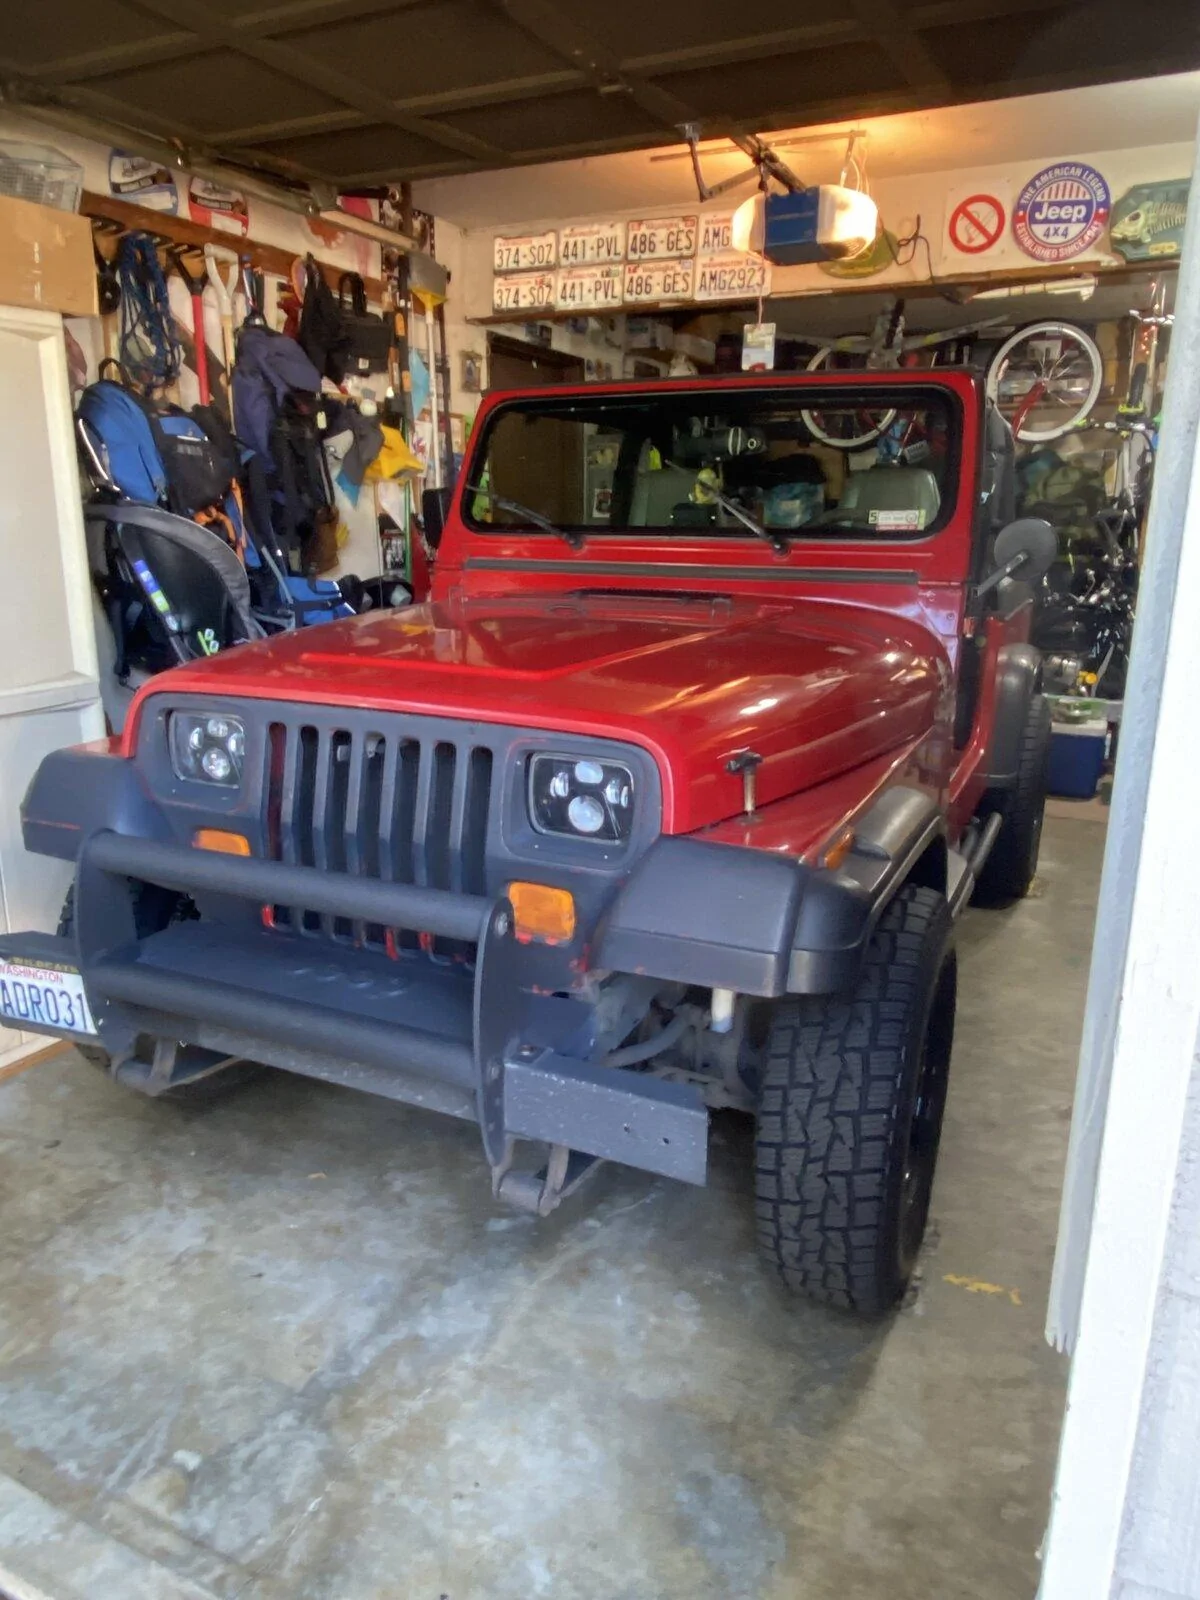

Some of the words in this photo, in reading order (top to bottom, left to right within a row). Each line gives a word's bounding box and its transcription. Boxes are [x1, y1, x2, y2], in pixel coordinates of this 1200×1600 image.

[1020, 185, 1037, 204] THE
[1035, 166, 1083, 188] AMERICAN
[1082, 170, 1106, 202] LEGEND
[1034, 202, 1087, 222] Jeep
[1016, 222, 1058, 259] ESTABLISHED
[1058, 238, 1086, 258] SINCE
[699, 266, 766, 292] AMG2923
